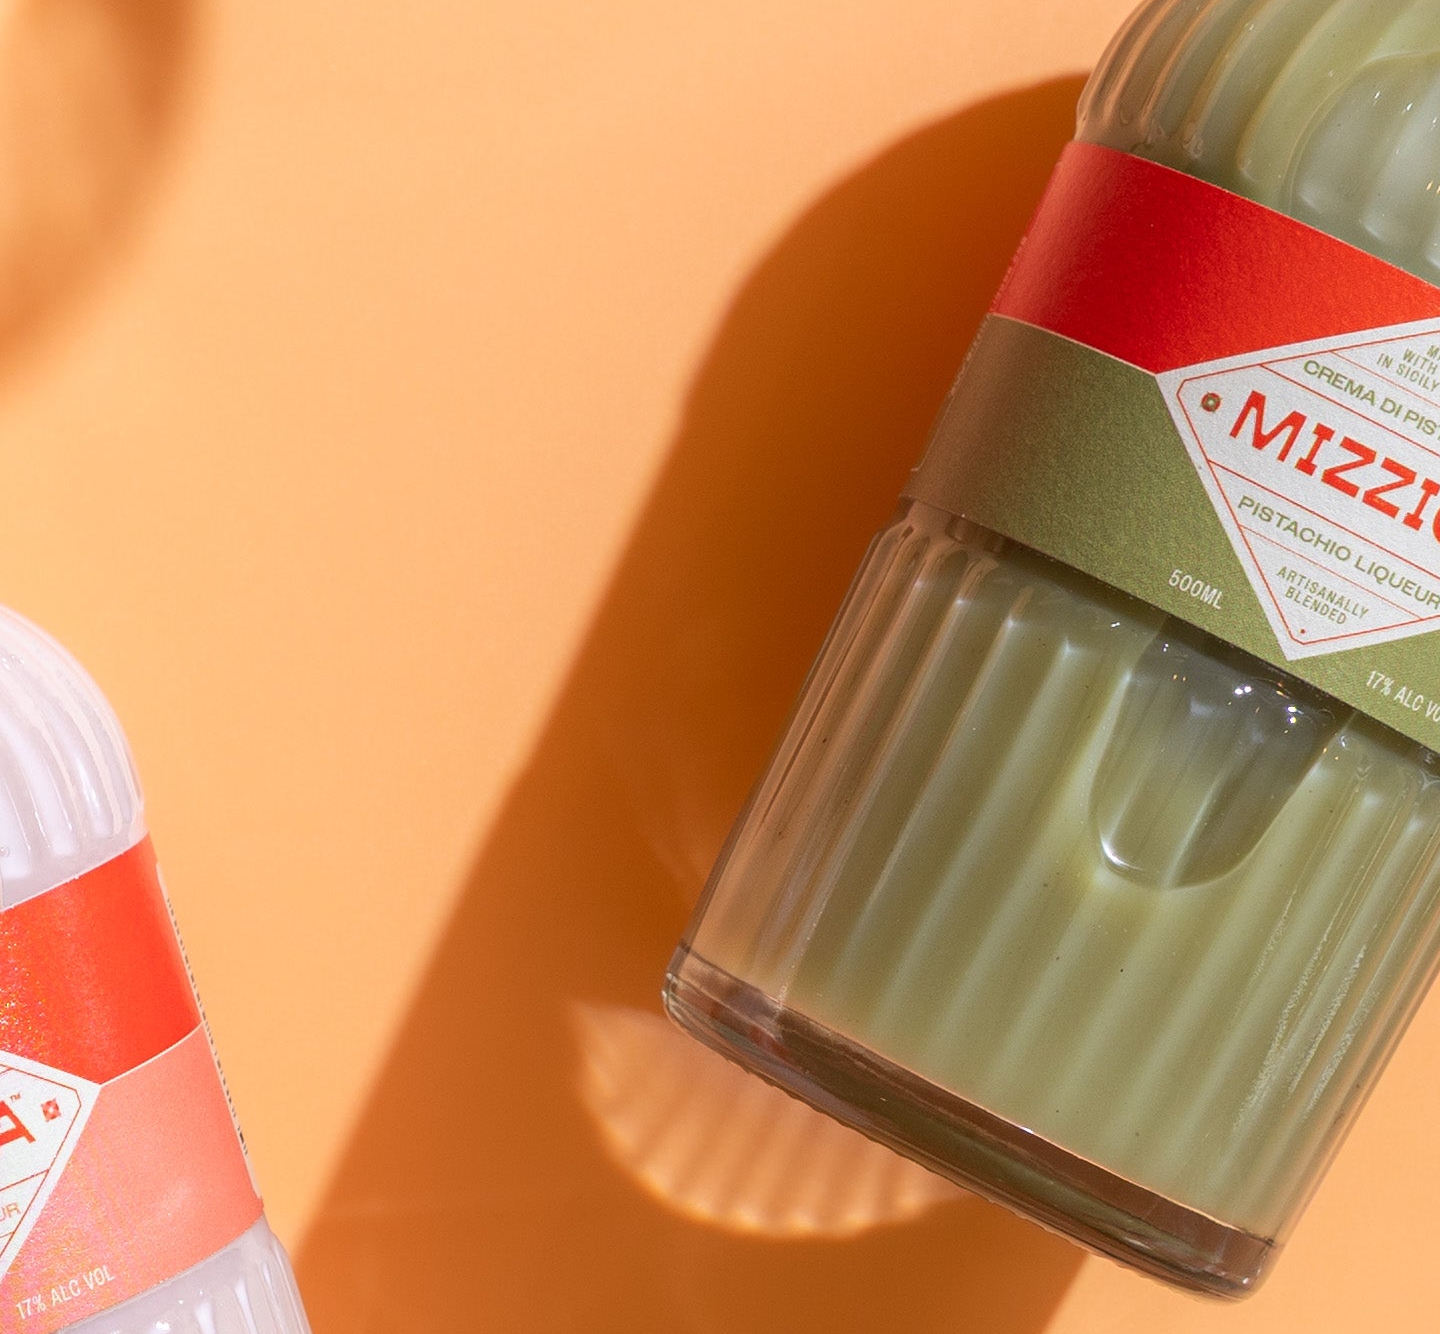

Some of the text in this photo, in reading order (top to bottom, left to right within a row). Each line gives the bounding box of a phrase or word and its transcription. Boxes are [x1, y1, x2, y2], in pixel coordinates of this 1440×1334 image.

[1376, 353, 1393, 368] IN
[1396, 364, 1440, 392] SICILY
[1403, 348, 1437, 374] WITH
[1303, 359, 1376, 406] CREMA
[1380, 397, 1403, 418] DI
[1238, 496, 1351, 561] PISTACHIO
[1169, 569, 1222, 609] 500ML
[1276, 566, 1370, 619] ARTISANALLY
[1285, 585, 1347, 625] BLENDED
[1366, 670, 1395, 696] 17%
[1393, 686, 1426, 711] ALC
[16, 1265, 116, 1320] 17% ALC VOL
